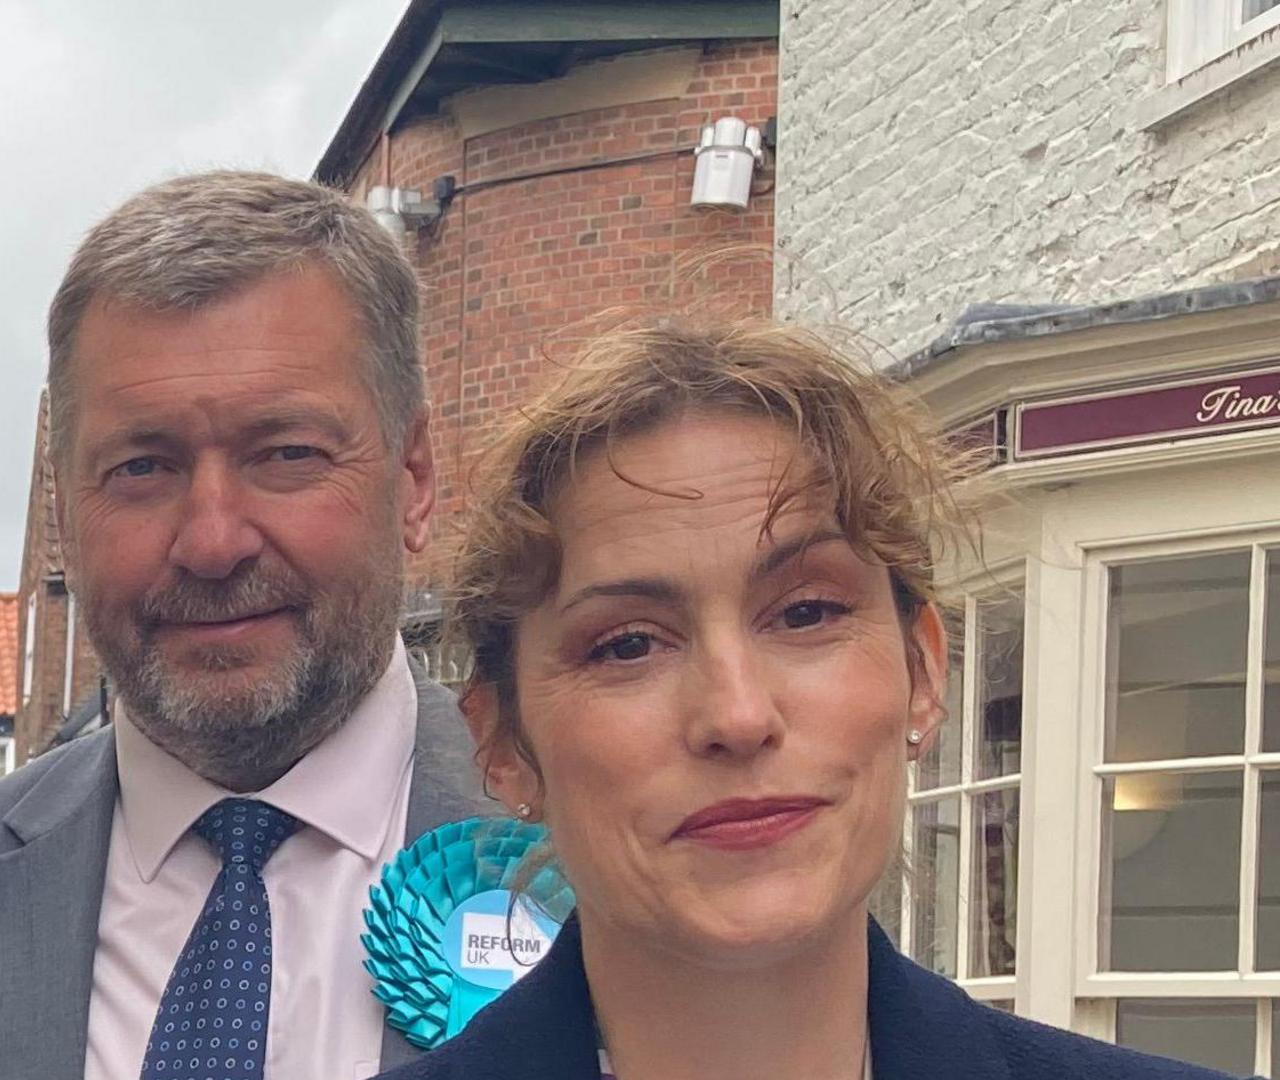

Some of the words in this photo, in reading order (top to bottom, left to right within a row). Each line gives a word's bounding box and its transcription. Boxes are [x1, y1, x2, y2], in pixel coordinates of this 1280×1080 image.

[1196, 385, 1280, 422] Tina
[468, 934, 541, 954] REFORM
[467, 950, 489, 964] UK
